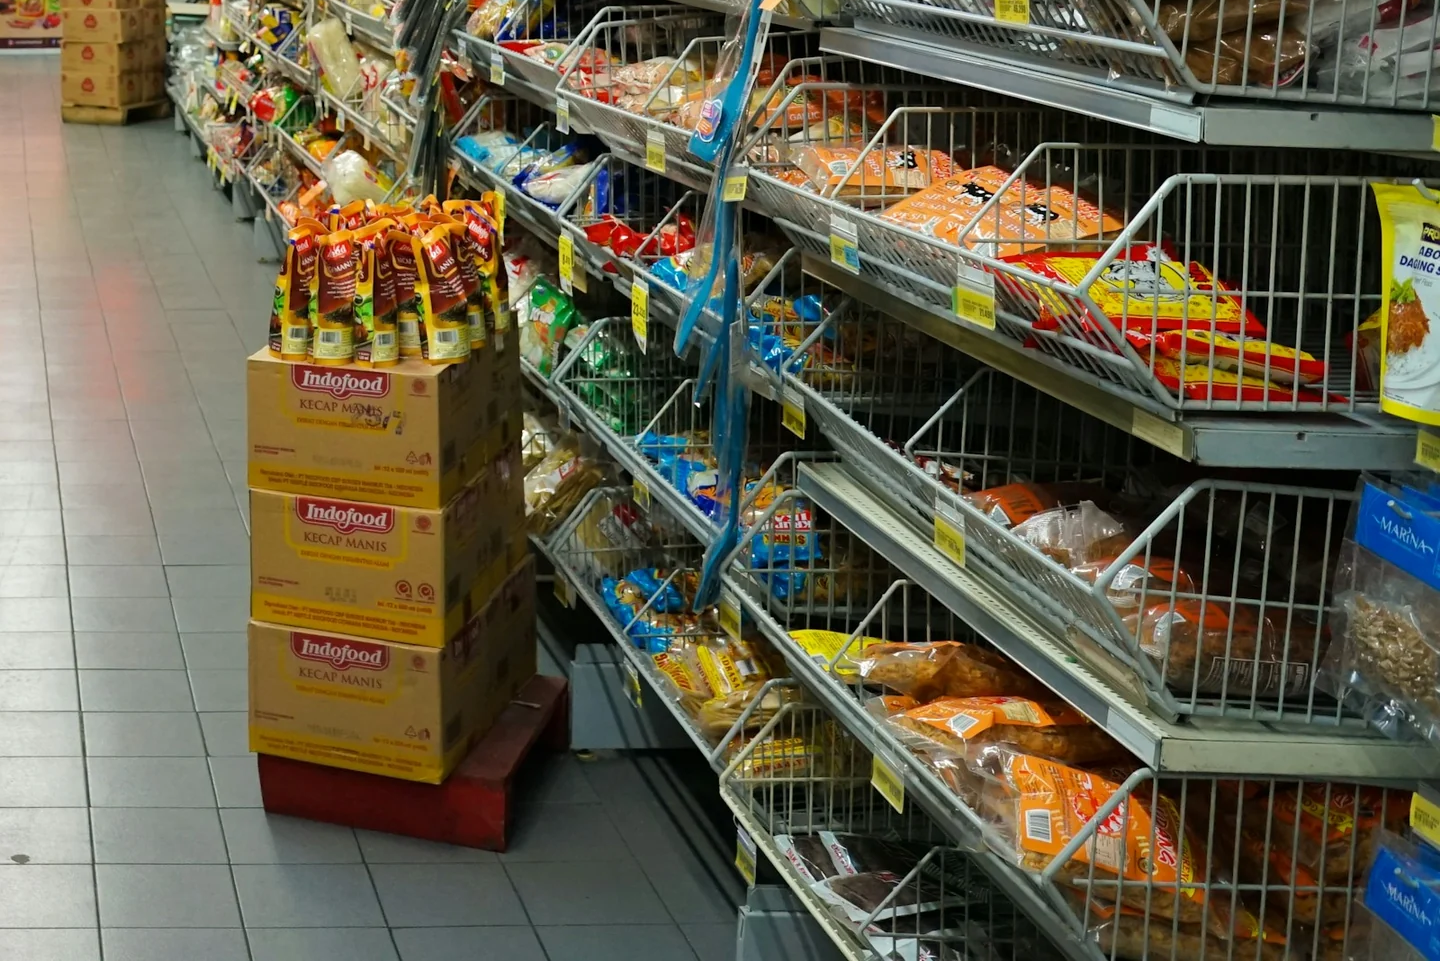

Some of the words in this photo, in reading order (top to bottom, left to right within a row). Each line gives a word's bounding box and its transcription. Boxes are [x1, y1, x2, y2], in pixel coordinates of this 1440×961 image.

[1423, 226, 1440, 240] PRO
[1419, 246, 1440, 260] ABO
[440, 256, 455, 273] ANIS
[1400, 255, 1434, 274] DAGING
[301, 370, 383, 395] Indofood
[299, 399, 338, 412] KECAP
[341, 403, 383, 417] MANIS
[305, 503, 387, 528] Indofood
[304, 532, 342, 546] KECAP
[345, 537, 387, 552] MANIS
[1372, 514, 1434, 554] MARINA
[301, 639, 383, 665] Indofood
[299, 667, 337, 682] KECAP
[341, 674, 383, 689] MANIS
[1381, 878, 1432, 926] MARINA
